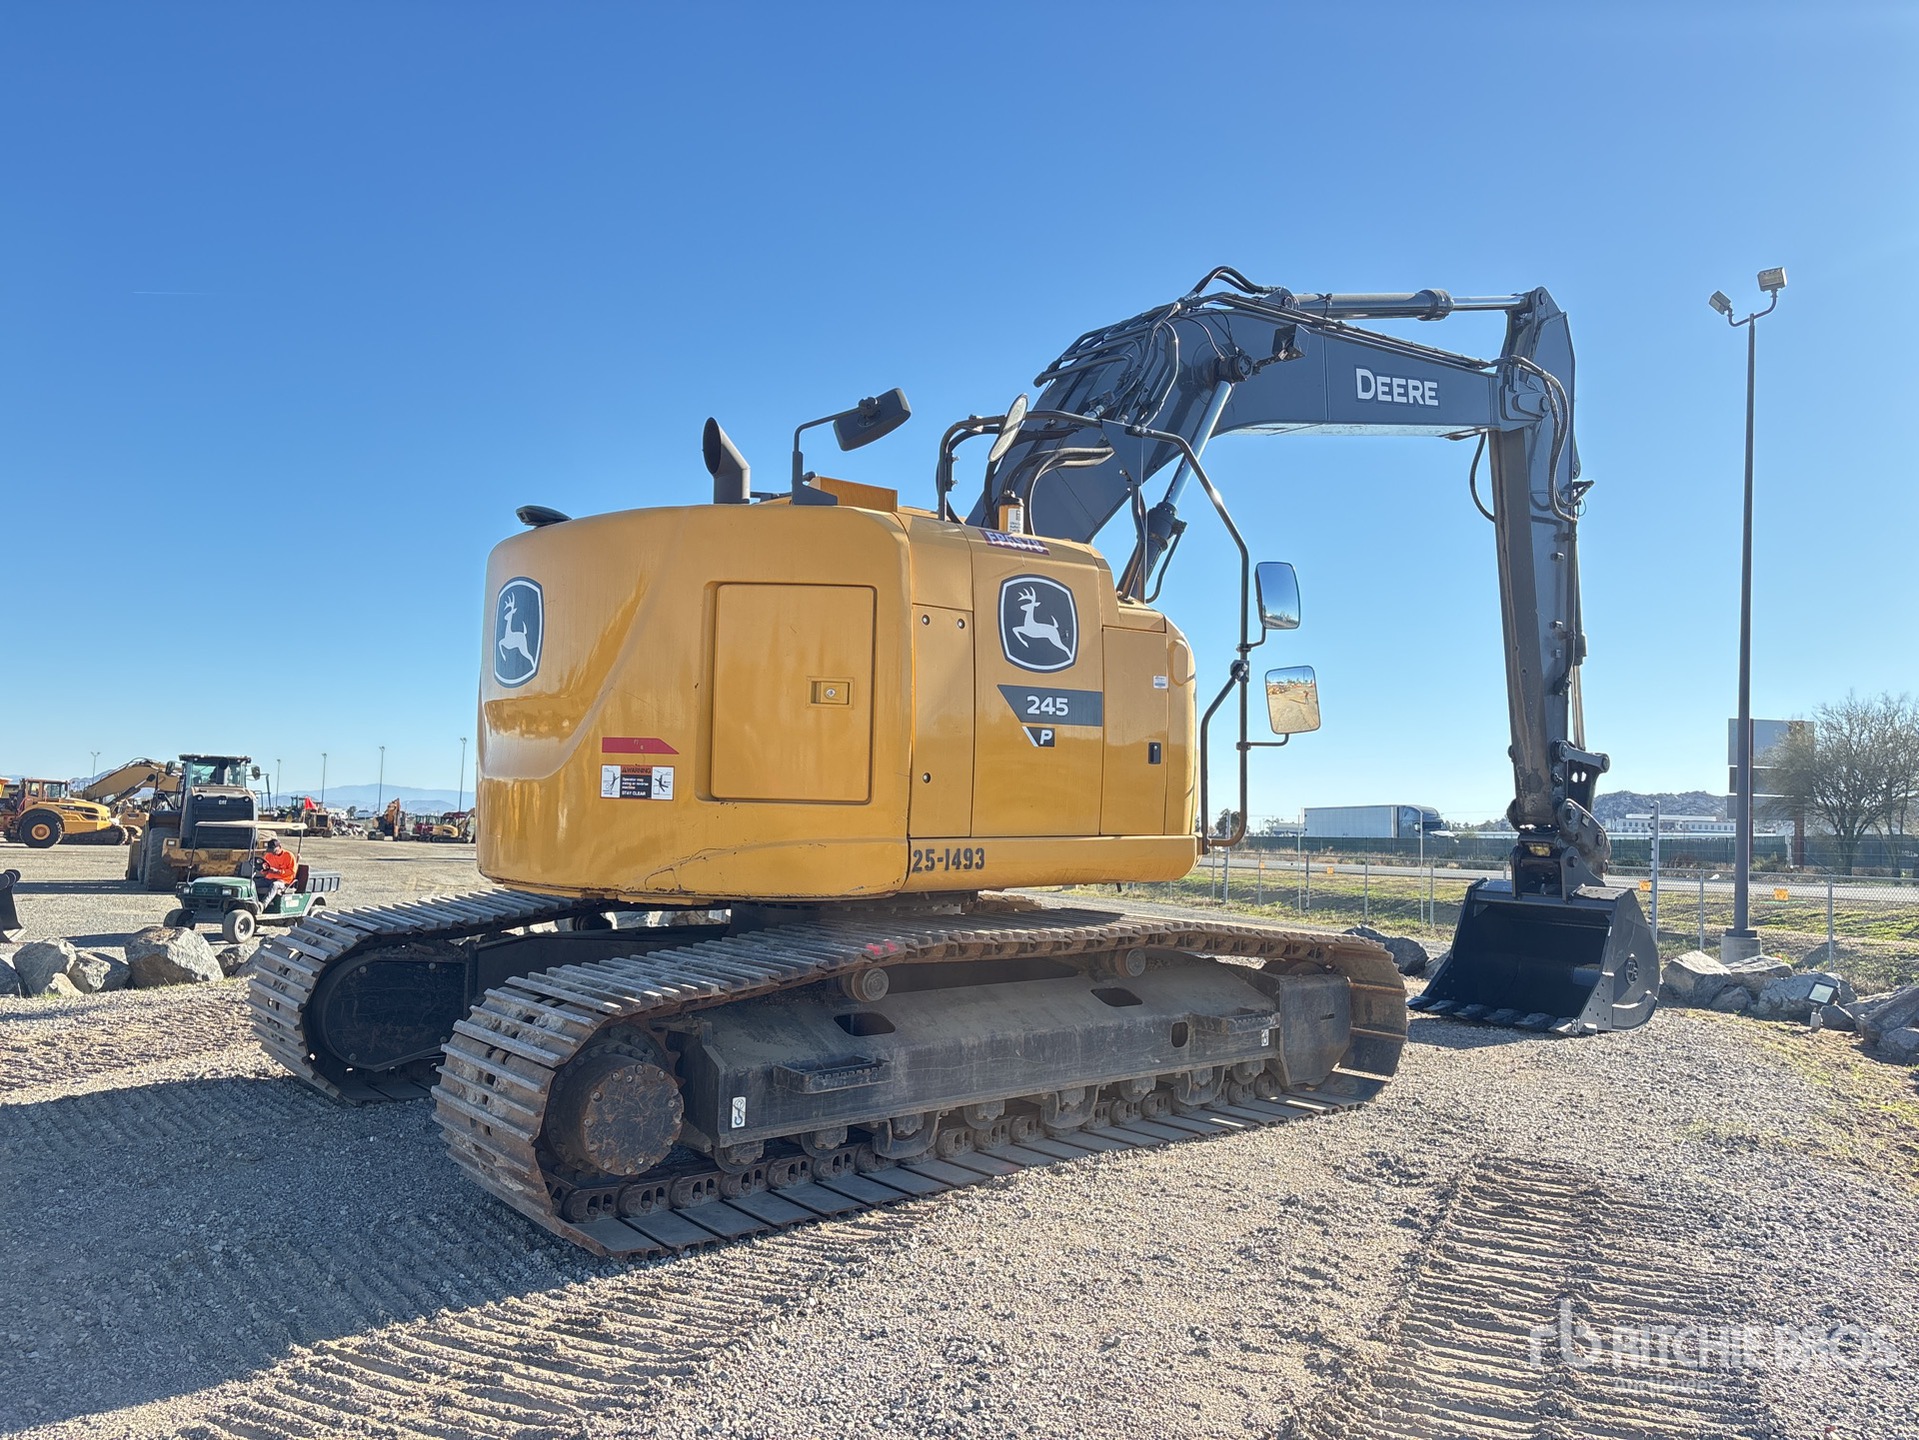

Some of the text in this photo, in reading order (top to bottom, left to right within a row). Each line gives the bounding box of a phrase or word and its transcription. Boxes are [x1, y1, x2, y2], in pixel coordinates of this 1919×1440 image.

[1355, 367, 1439, 407] DEERE
[1026, 695, 1069, 716] 245
[1039, 729, 1053, 745] P
[911, 847, 985, 873] 25-1493
